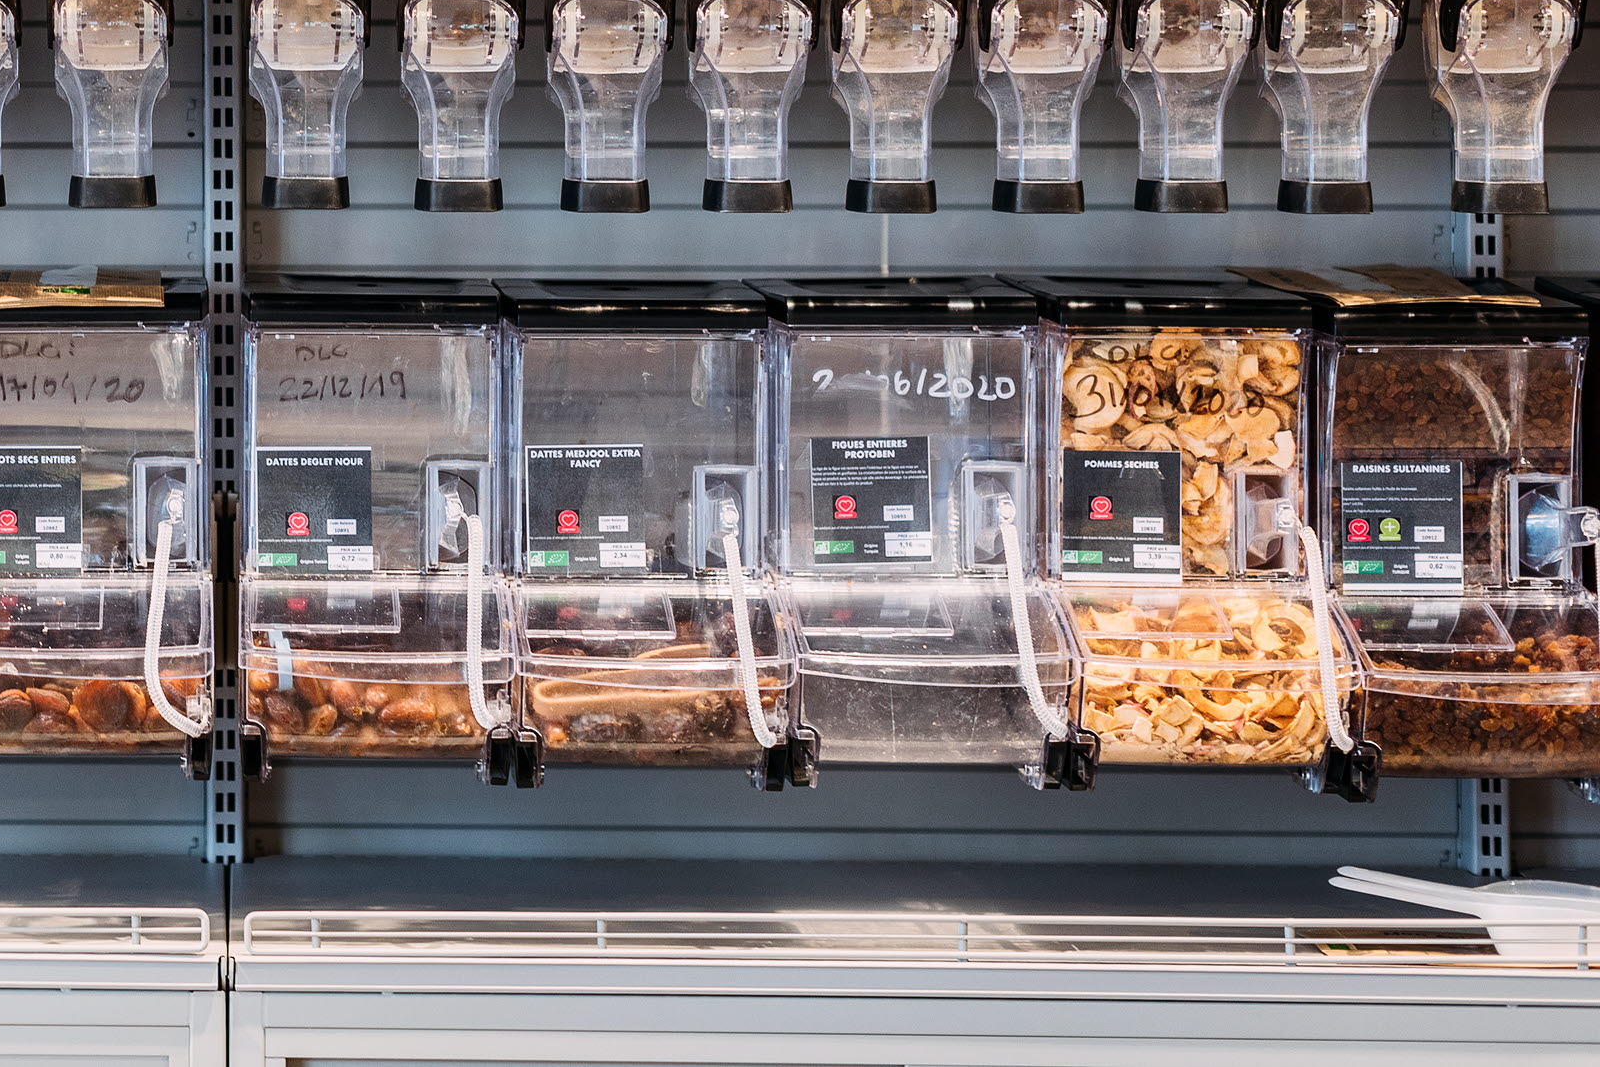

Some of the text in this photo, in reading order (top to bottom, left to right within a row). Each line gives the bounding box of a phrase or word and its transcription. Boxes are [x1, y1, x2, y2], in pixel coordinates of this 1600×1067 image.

[831, 439, 908, 449] FIGUES ENTIERES
[530, 449, 641, 459] DATTES MEDJOOL EXTRA
[844, 449, 896, 459] PROTOBEN
[17, 455, 39, 464] SECS
[40, 455, 77, 464] ENTIERS
[266, 457, 364, 466] DATTES DEGLET NOUR
[570, 459, 601, 468] FANCY
[1084, 459, 1160, 469] POMMES SECHEES
[1352, 464, 1451, 474] RAISINS SULTANINES
